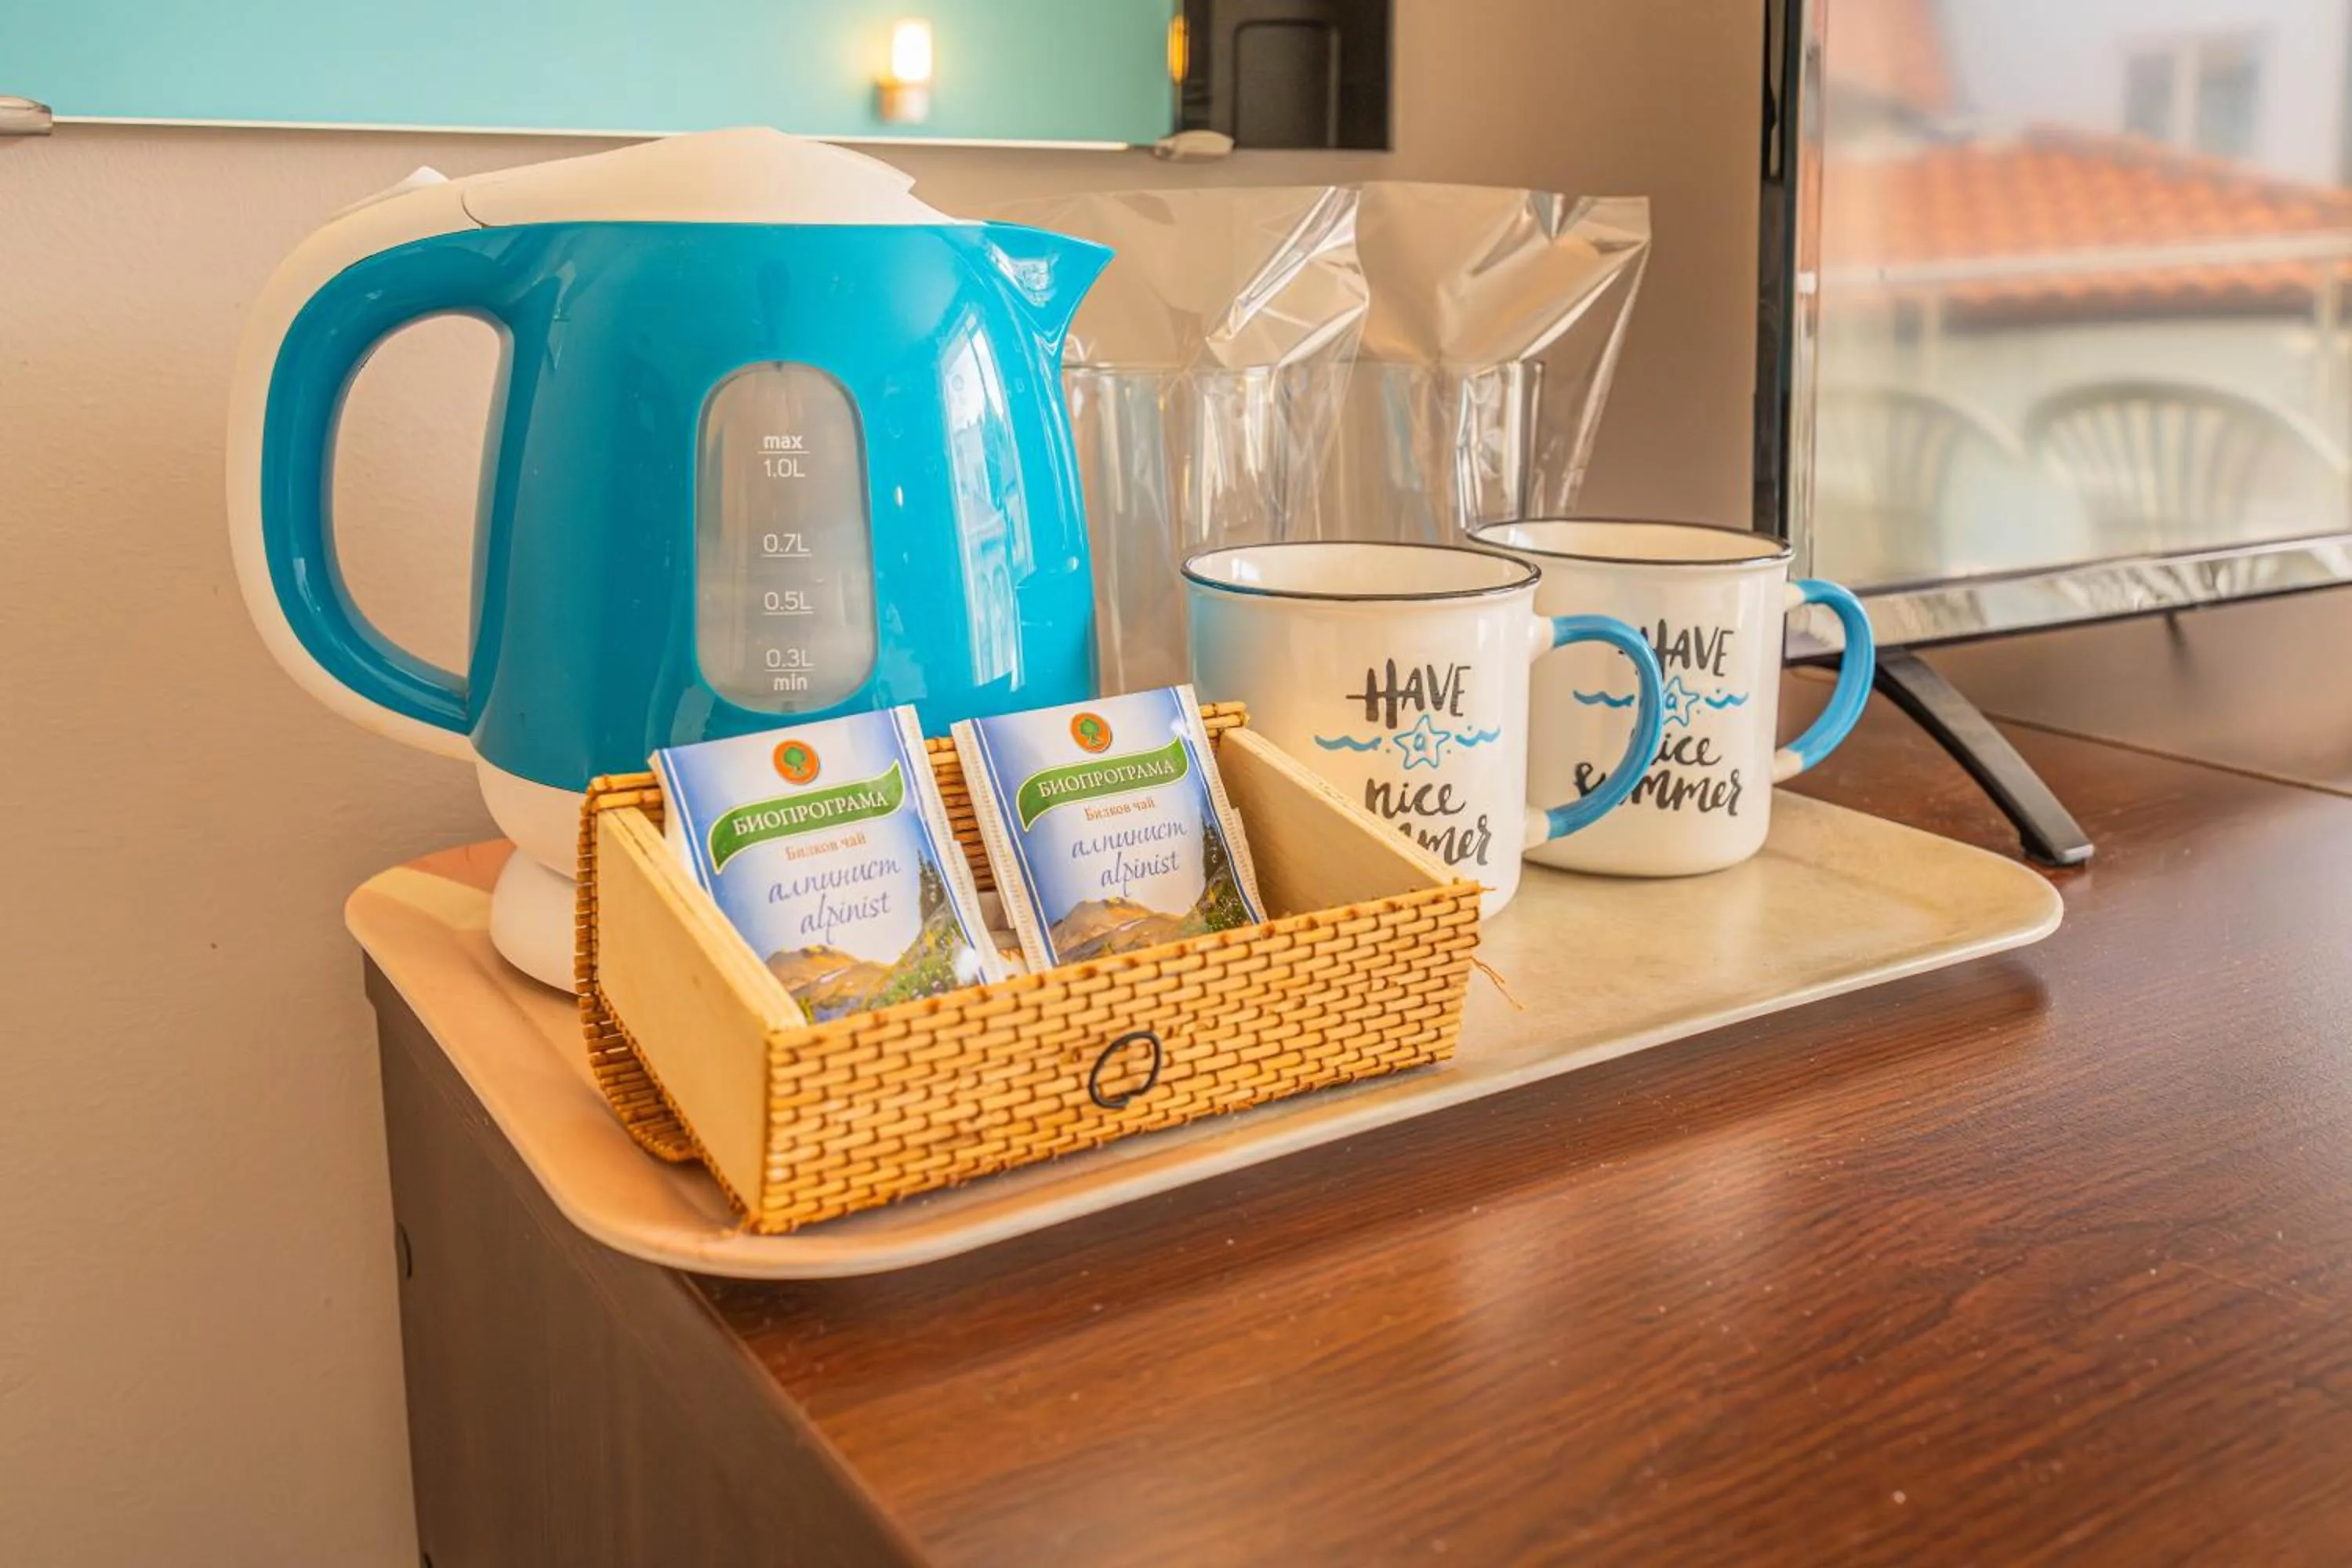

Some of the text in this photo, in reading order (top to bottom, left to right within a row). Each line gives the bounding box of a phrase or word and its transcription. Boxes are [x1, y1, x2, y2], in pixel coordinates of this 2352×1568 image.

[763, 435, 804, 450] max
[763, 458, 806, 478] 1.0L
[763, 533, 810, 553] 0.7L
[764, 591, 813, 611] 0.5L
[765, 648, 814, 668] 0.3L
[773, 674, 808, 691] min
[1345, 658, 1472, 729] HAVE
[1631, 733, 1722, 766] ice
[1036, 759, 1175, 798] БИОПРОГРАМА
[1573, 762, 1743, 816] smmer
[731, 789, 888, 837] БИОПРОГРАМА
[1084, 796, 1156, 822] Билков чай
[1365, 778, 1466, 819] nice
[1071, 821, 1188, 858] алпинист
[768, 857, 902, 904] алпинист
[1100, 851, 1180, 898] alpinist
[800, 891, 892, 945] alpinist
